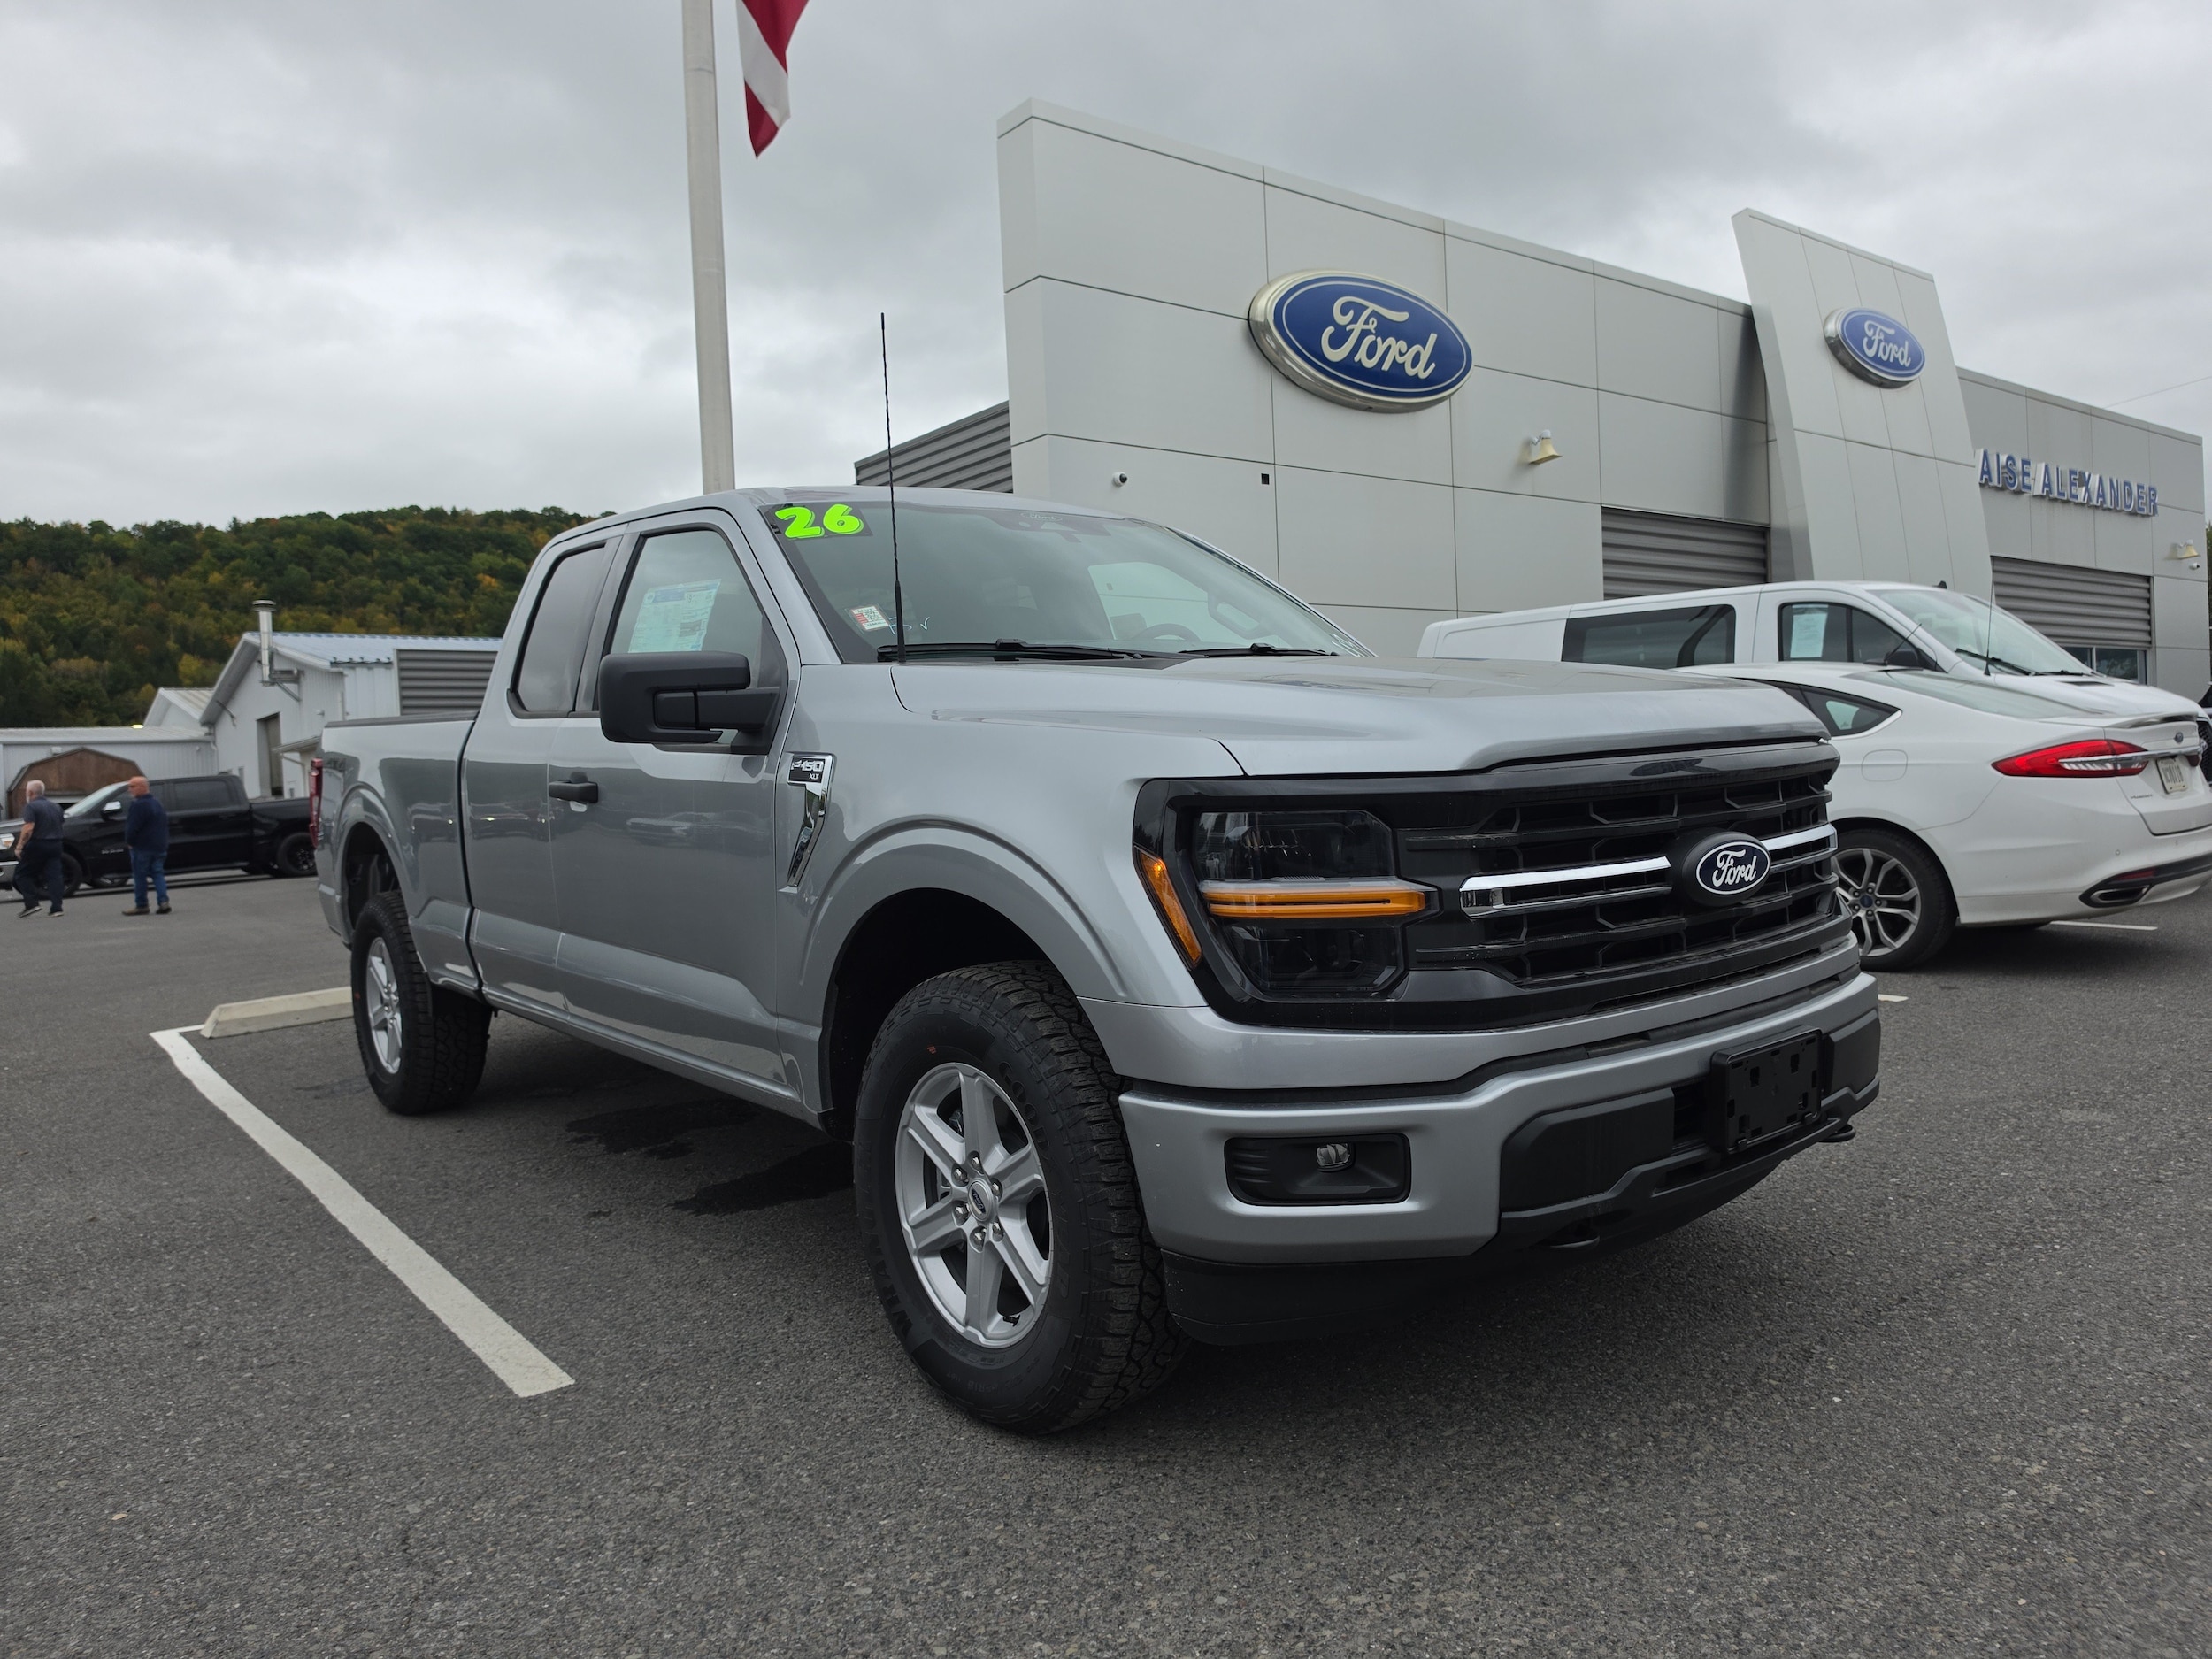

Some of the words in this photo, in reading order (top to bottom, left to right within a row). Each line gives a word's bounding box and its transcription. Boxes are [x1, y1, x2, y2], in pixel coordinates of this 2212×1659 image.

[1321, 296, 1438, 380] Ford
[1863, 319, 1911, 367] Ford
[2037, 461, 2159, 517] ALEXANDER
[775, 503, 864, 539] 26
[790, 759, 825, 772] F-150
[1711, 849, 1758, 887] Ford
